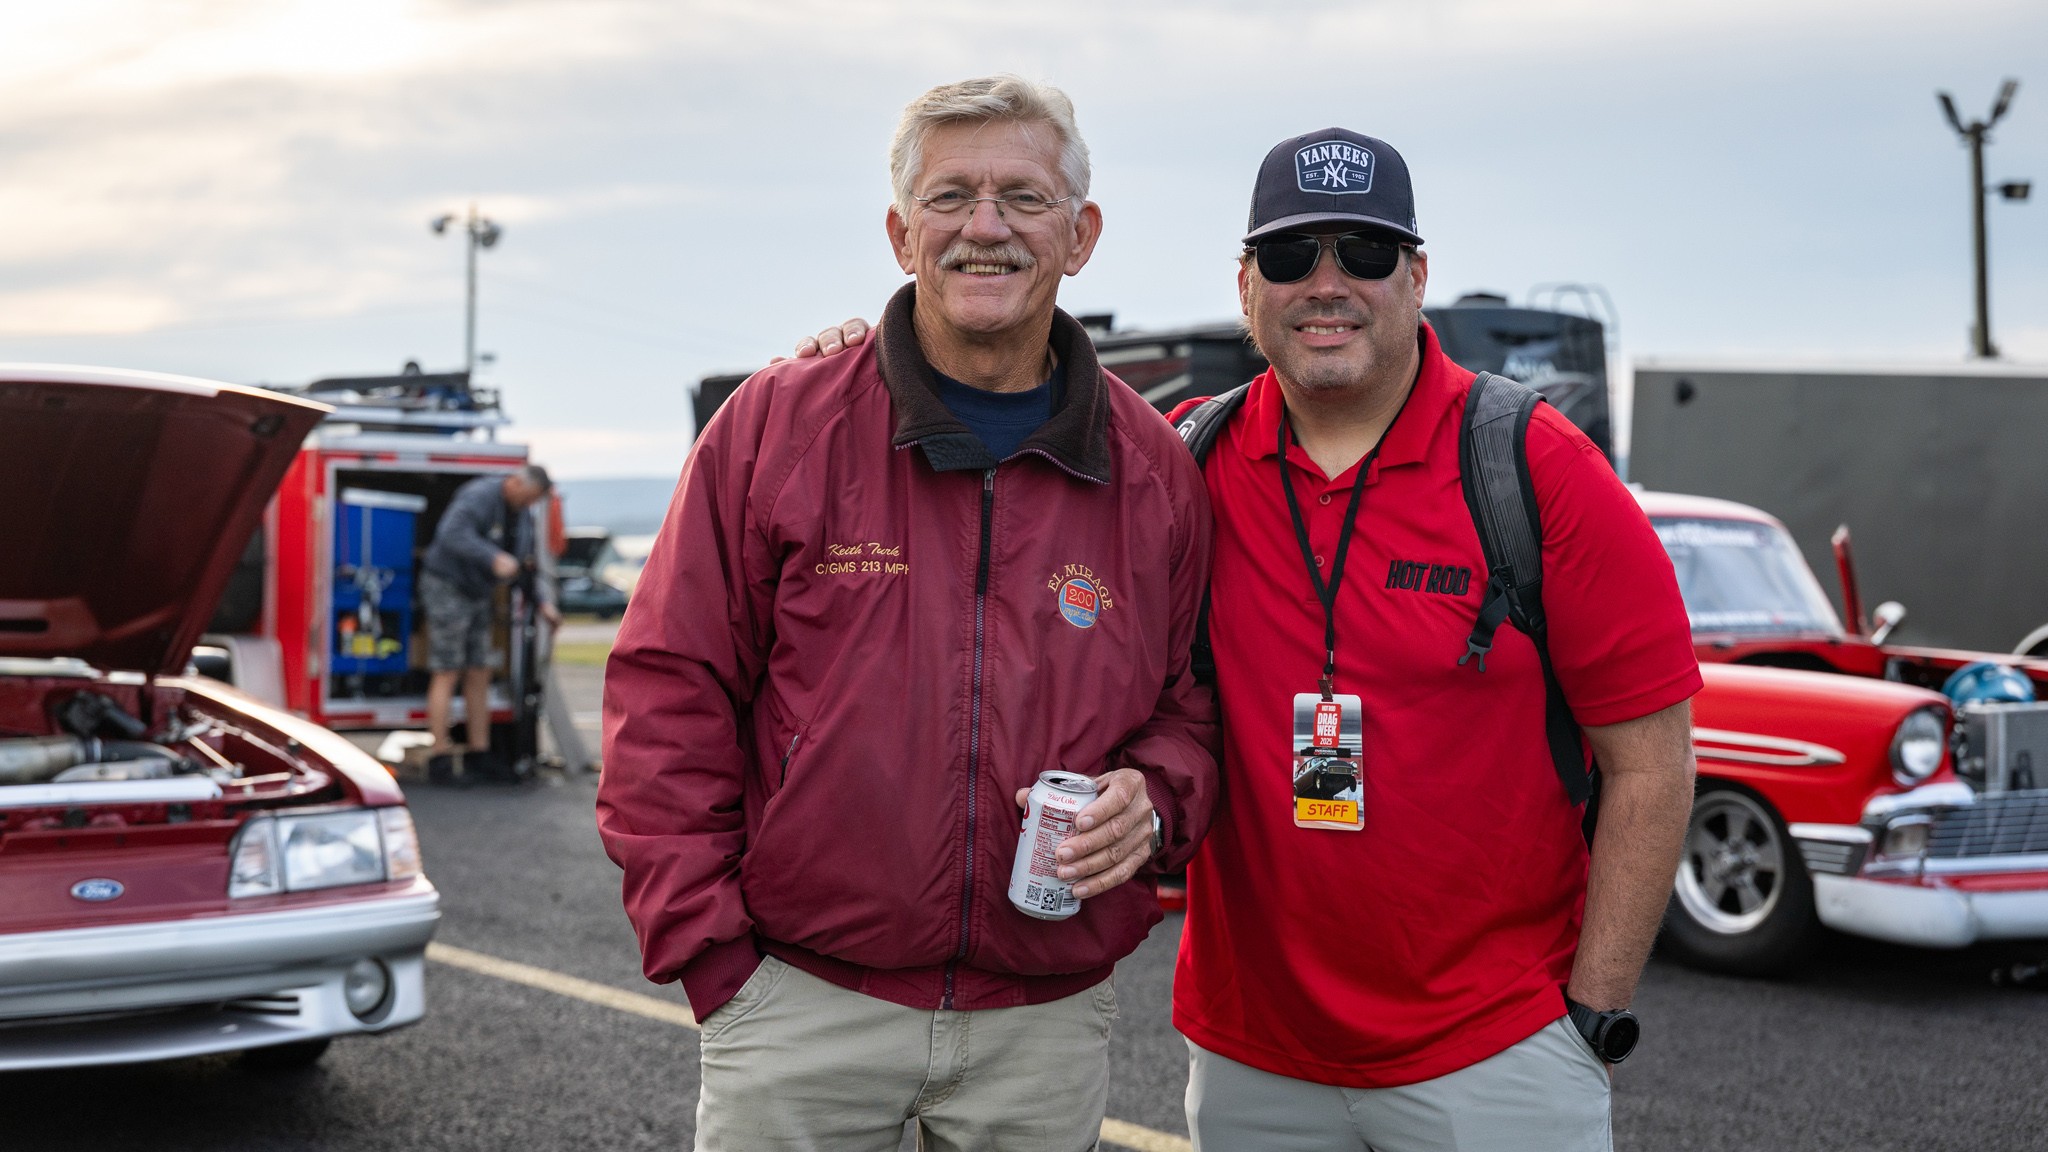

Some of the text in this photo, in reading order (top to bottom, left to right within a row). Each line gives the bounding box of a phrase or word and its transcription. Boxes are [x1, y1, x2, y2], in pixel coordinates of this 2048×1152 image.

[1300, 144, 1369, 167] YANKEES
[1322, 160, 1348, 188] NY
[828, 542, 900, 557] Keith Turk
[815, 561, 856, 575] C/GMS
[861, 561, 881, 572] 213
[1385, 560, 1472, 596] HOT ROD
[1047, 563, 1113, 611] EL MIRAGE
[1068, 588, 1093, 607] 200
[1317, 712, 1338, 725] DRAG
[1316, 724, 1337, 737] WEEK
[1319, 737, 1333, 746] 2025
[1307, 803, 1349, 817] STAFF
